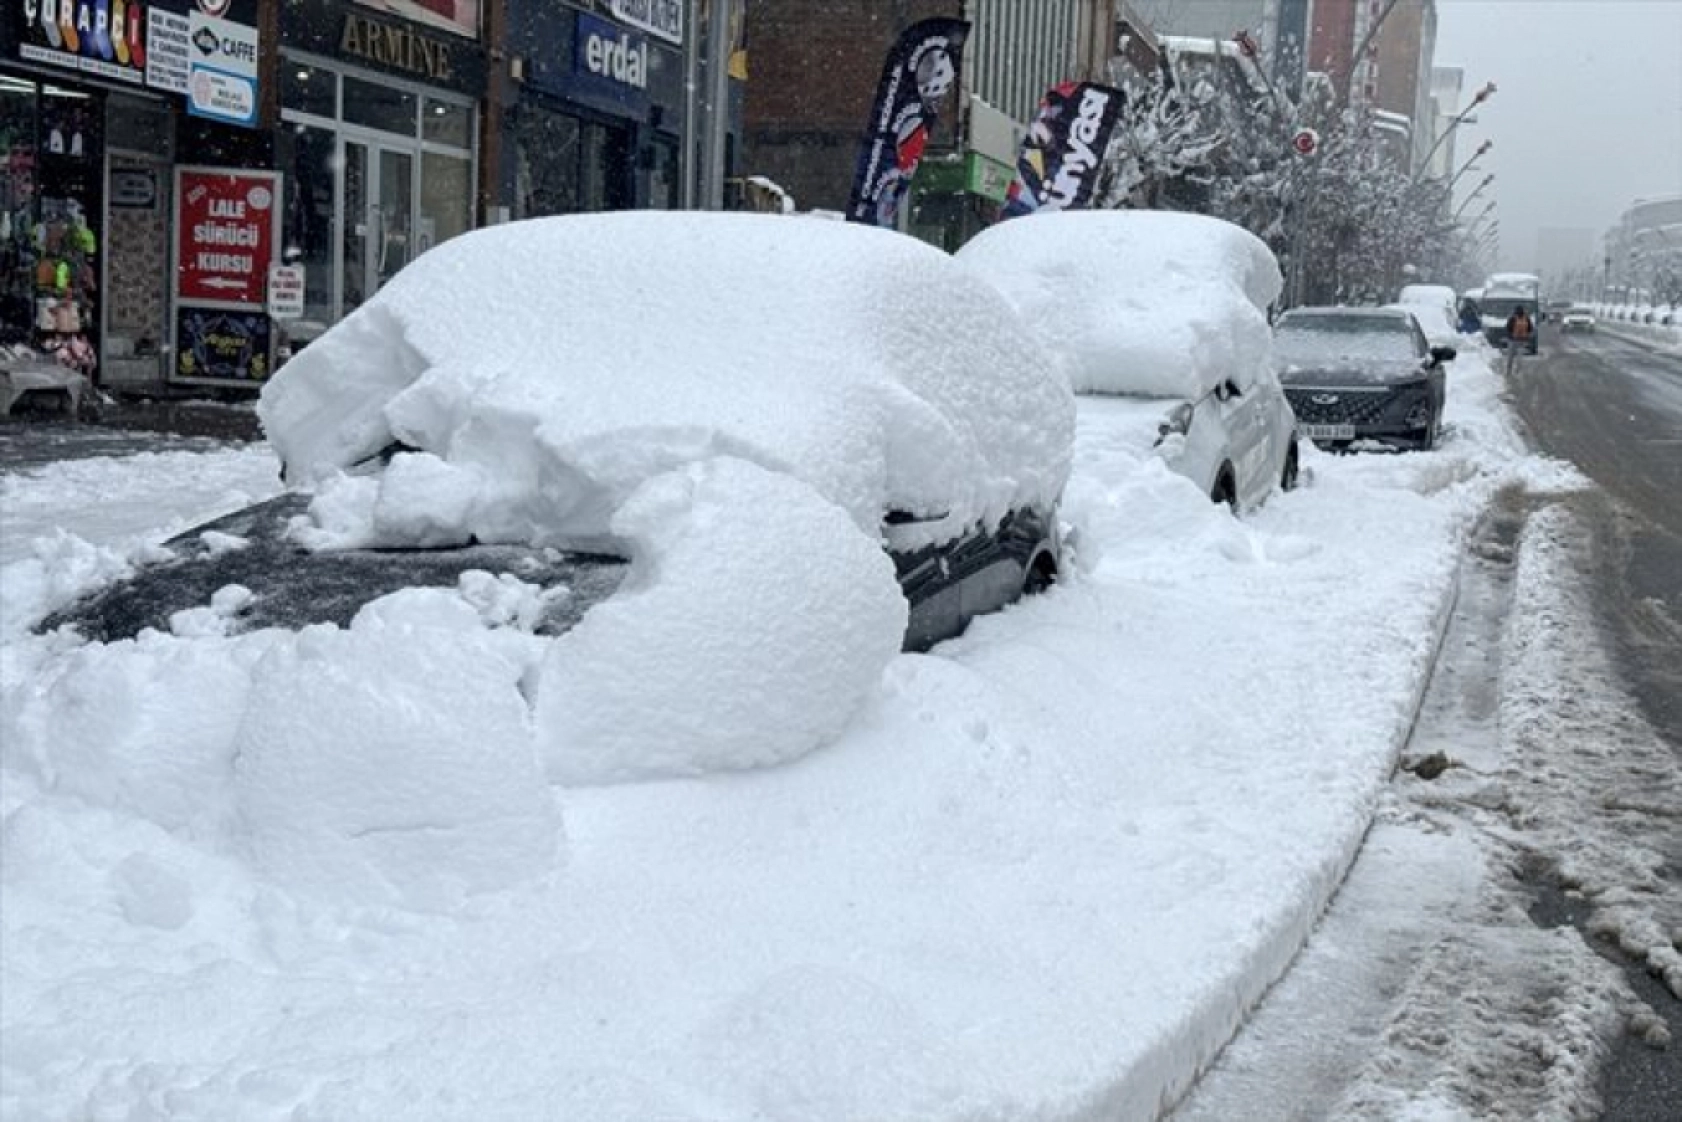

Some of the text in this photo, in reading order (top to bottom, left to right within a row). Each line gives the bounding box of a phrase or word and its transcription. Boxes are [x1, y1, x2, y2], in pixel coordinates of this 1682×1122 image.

[222, 37, 256, 62] CAFFE
[342, 13, 452, 80] ARMİNE
[585, 31, 647, 88] erdal
[208, 198, 246, 219] LALE
[193, 220, 259, 247] SÜRÜCÜ
[196, 251, 253, 274] KURSU
